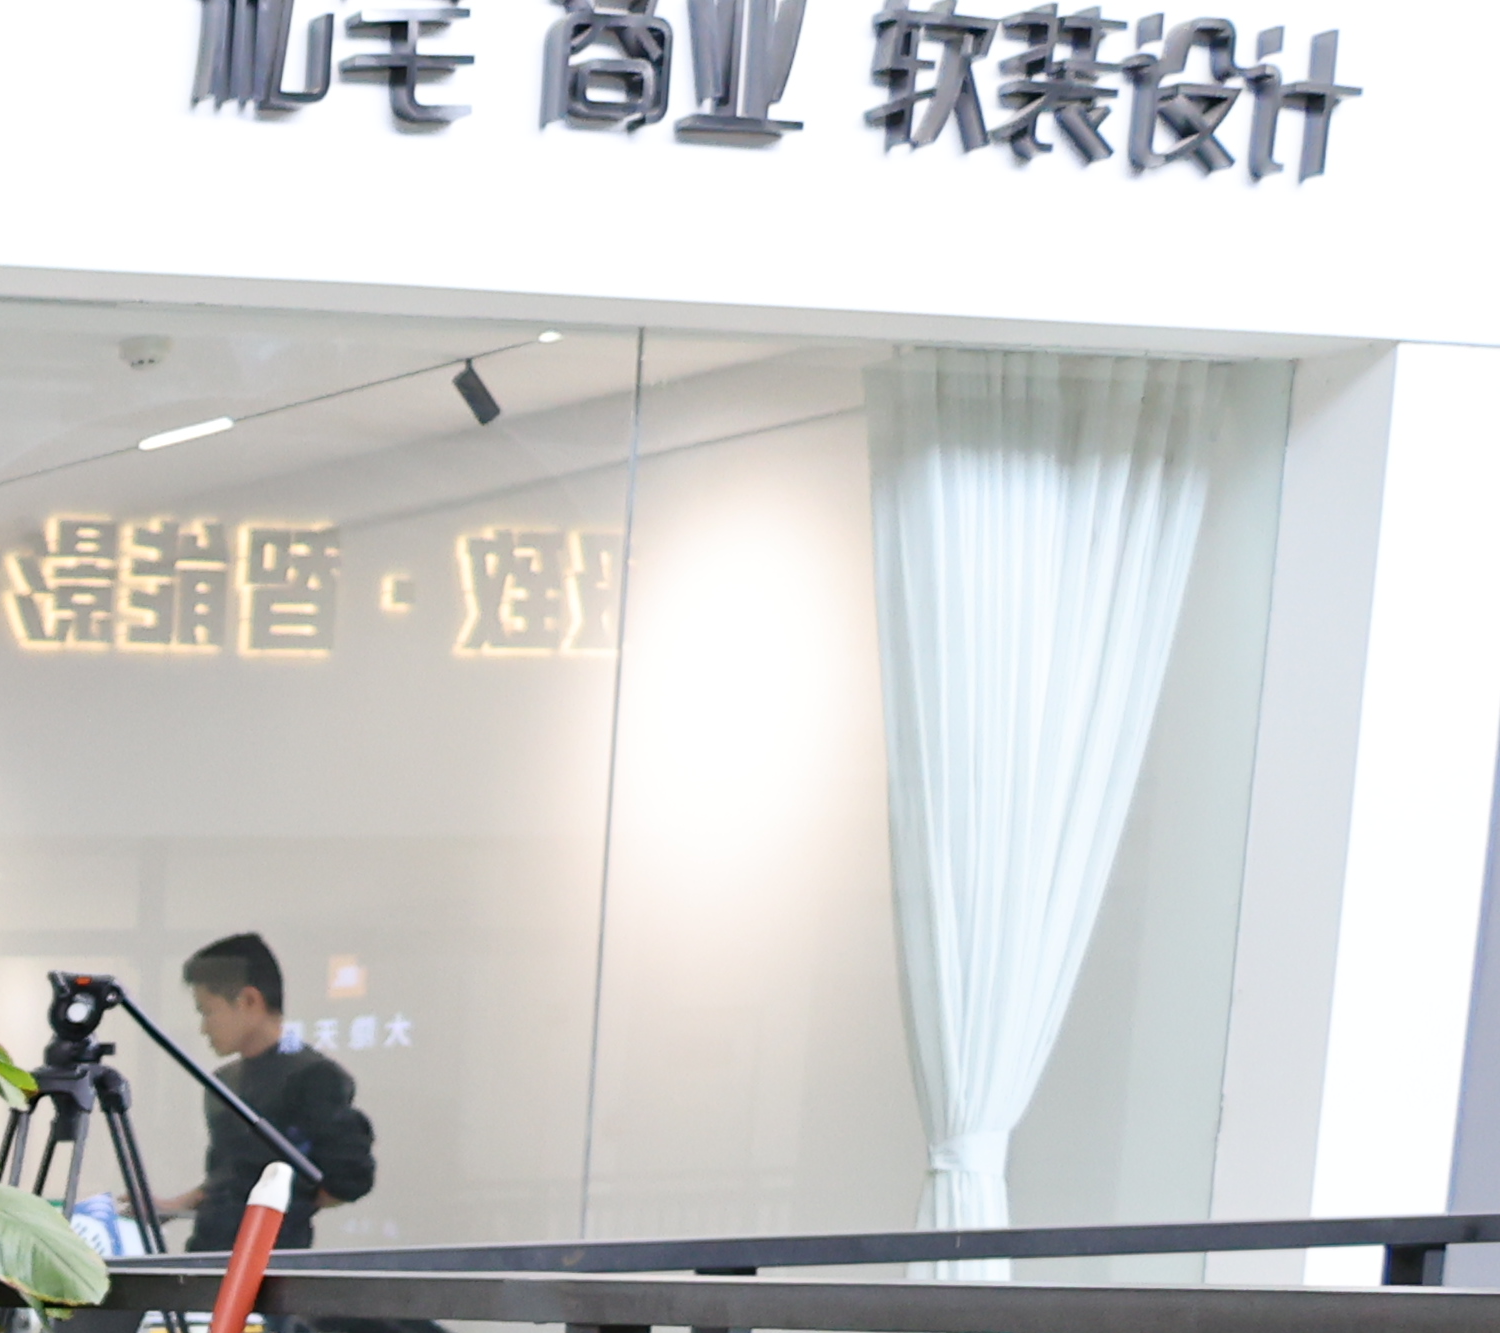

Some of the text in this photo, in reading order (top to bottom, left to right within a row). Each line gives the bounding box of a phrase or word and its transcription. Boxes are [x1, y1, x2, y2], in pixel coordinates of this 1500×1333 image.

[538, 0, 804, 142] 商业
[863, 0, 1364, 186] 软装设计
